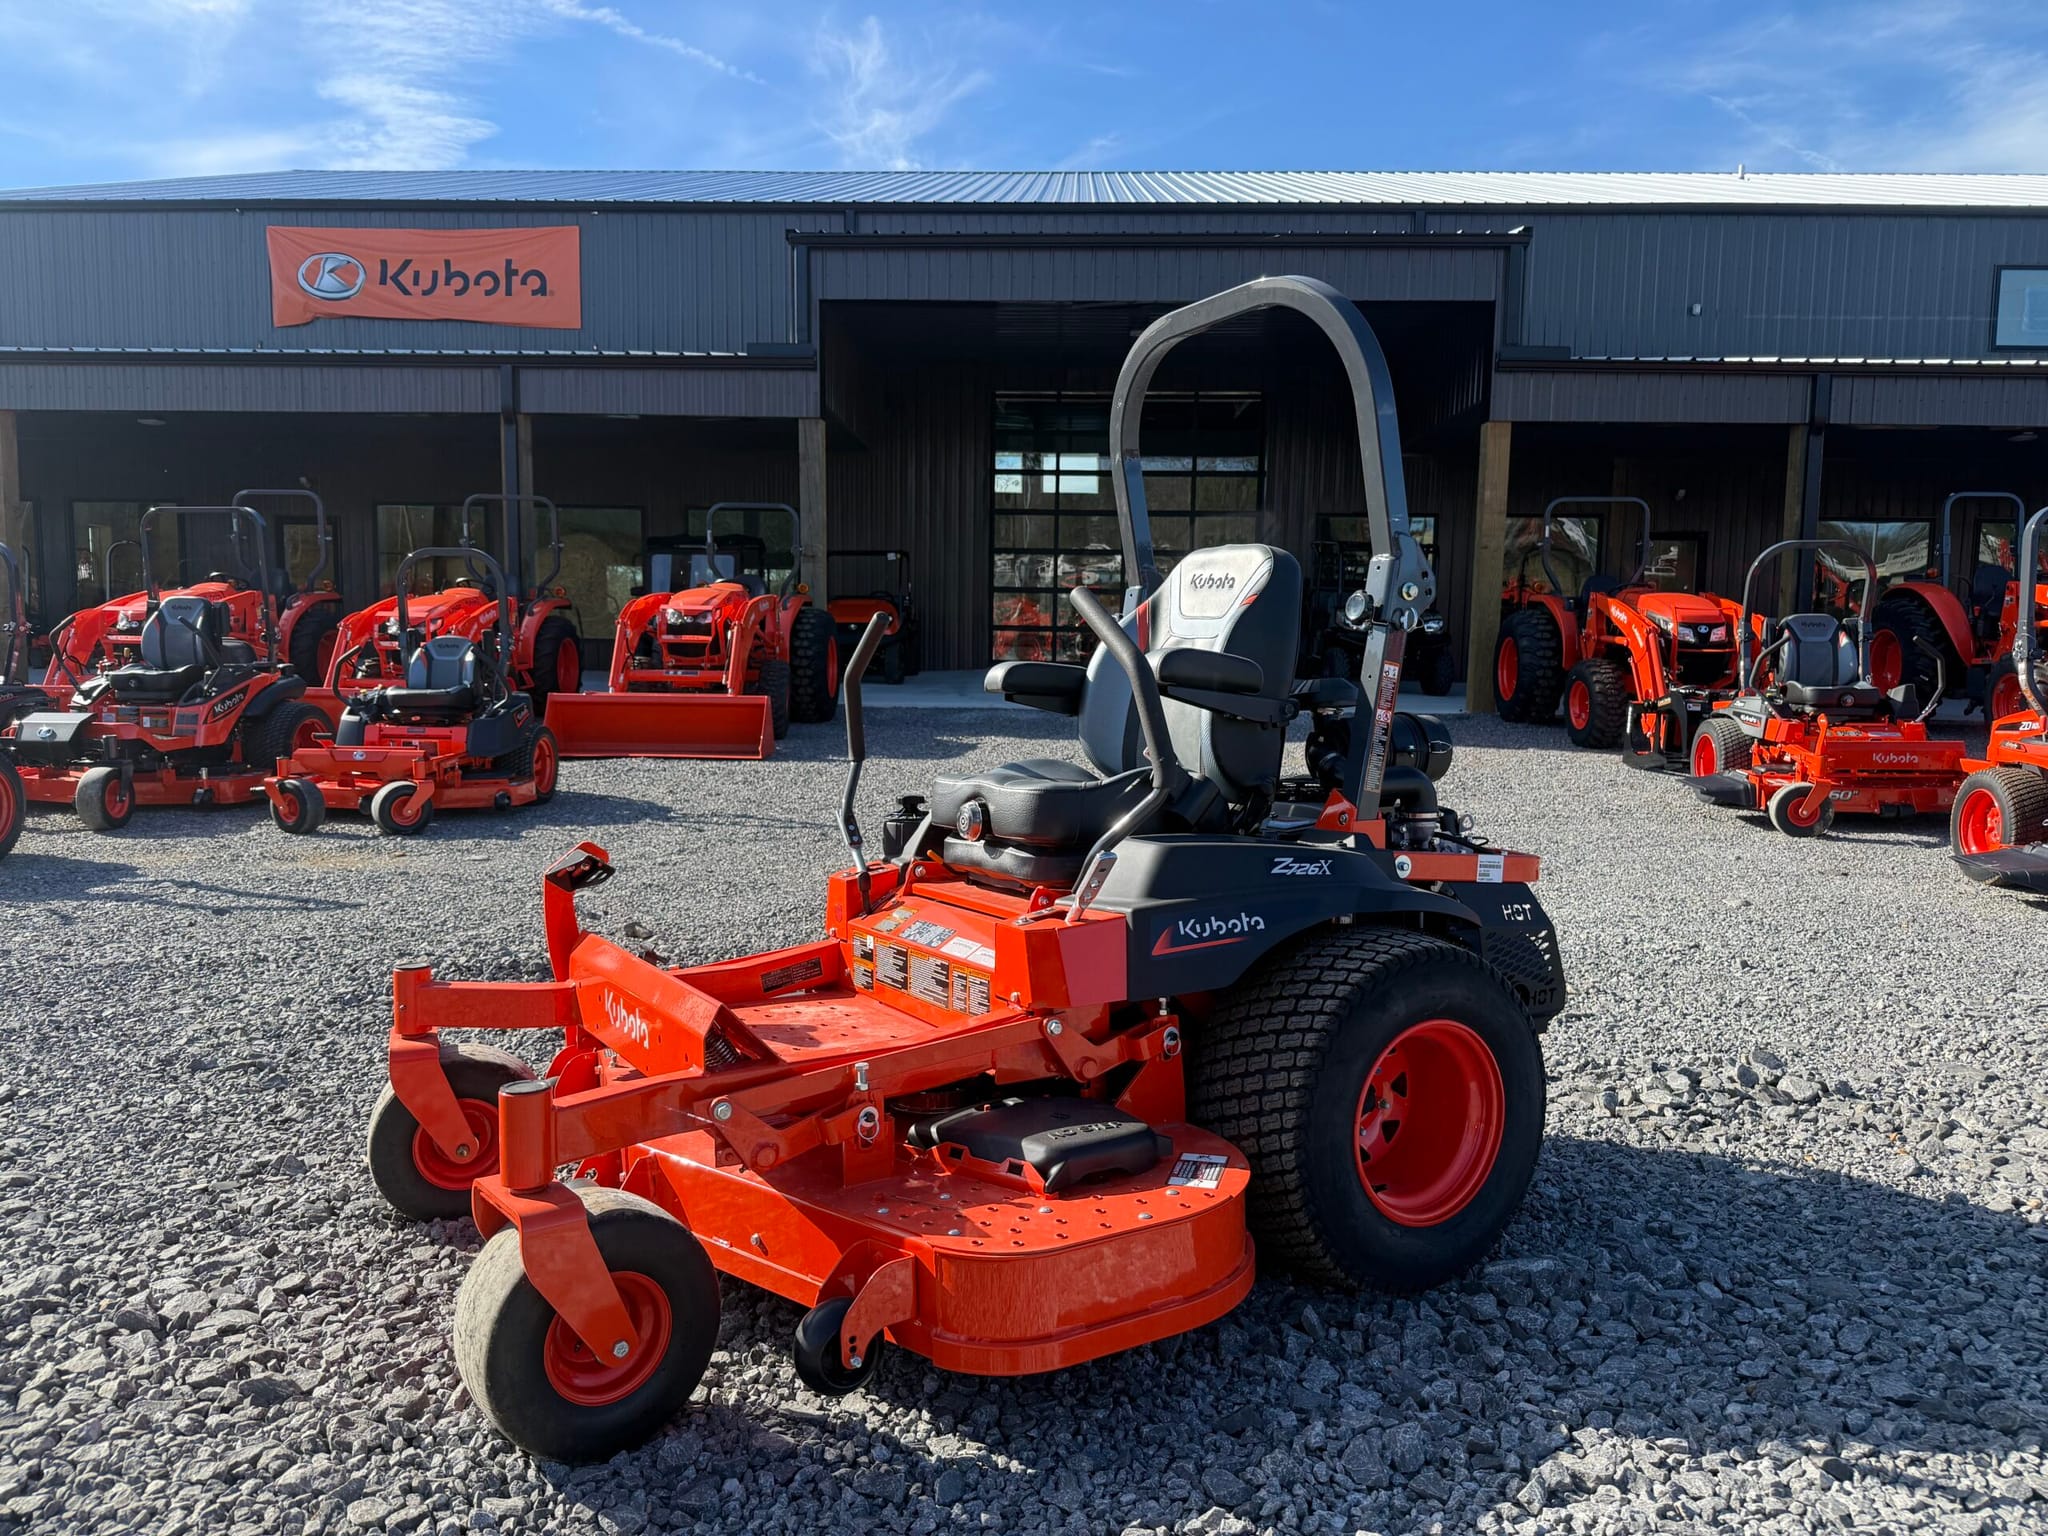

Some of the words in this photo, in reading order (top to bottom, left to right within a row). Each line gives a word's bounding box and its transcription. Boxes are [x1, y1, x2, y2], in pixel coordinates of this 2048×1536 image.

[378, 258, 548, 297] Kubota
[1190, 572, 1236, 589] Kubota
[213, 693, 244, 713] Kubota
[1872, 752, 1919, 764] Kubota
[1828, 789, 1860, 801] 60"
[1271, 857, 1335, 876] Z726X
[1501, 903, 1532, 921] HOT
[1178, 912, 1265, 939] Kubota
[604, 987, 649, 1049] Kubota
[1047, 1129, 1077, 1140] NO
